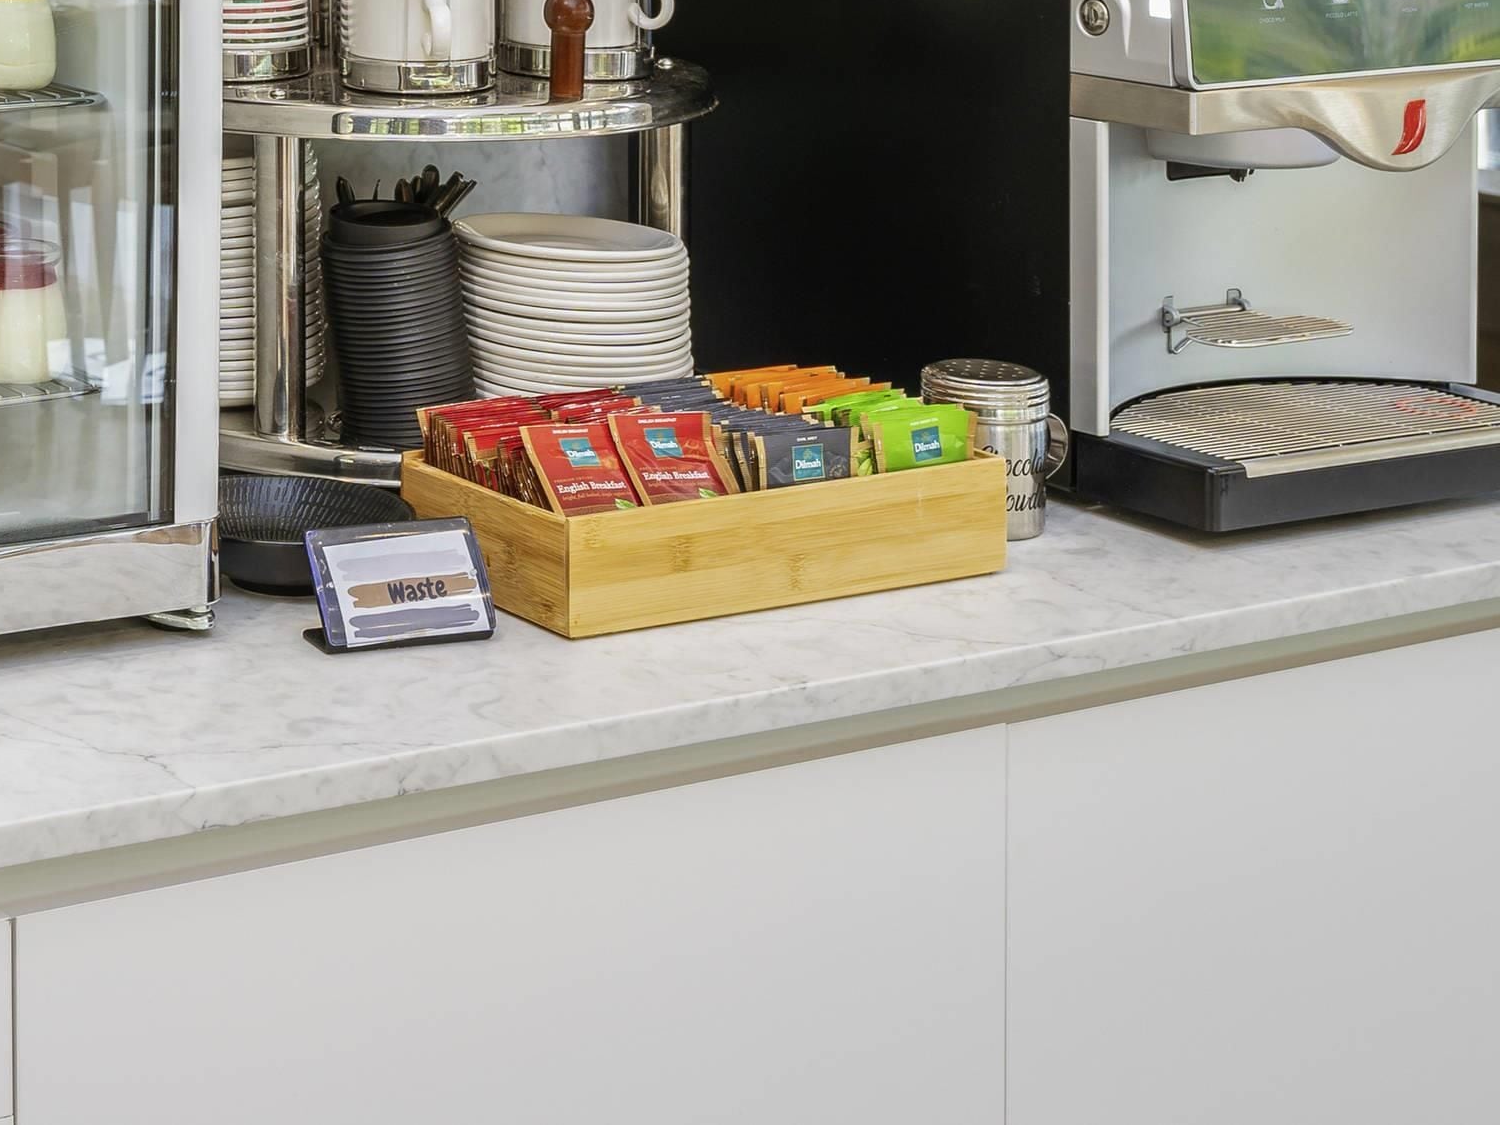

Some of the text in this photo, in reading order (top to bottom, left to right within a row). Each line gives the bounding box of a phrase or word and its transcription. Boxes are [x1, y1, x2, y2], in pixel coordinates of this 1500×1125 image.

[650, 441, 678, 449] Dilmah
[914, 440, 940, 452] Dilmah
[566, 449, 596, 458] Dilmah
[795, 459, 821, 469] Dilmah
[642, 471, 710, 481] English Breakfast
[557, 480, 627, 493] English Breakfast
[387, 577, 448, 604] Waste
